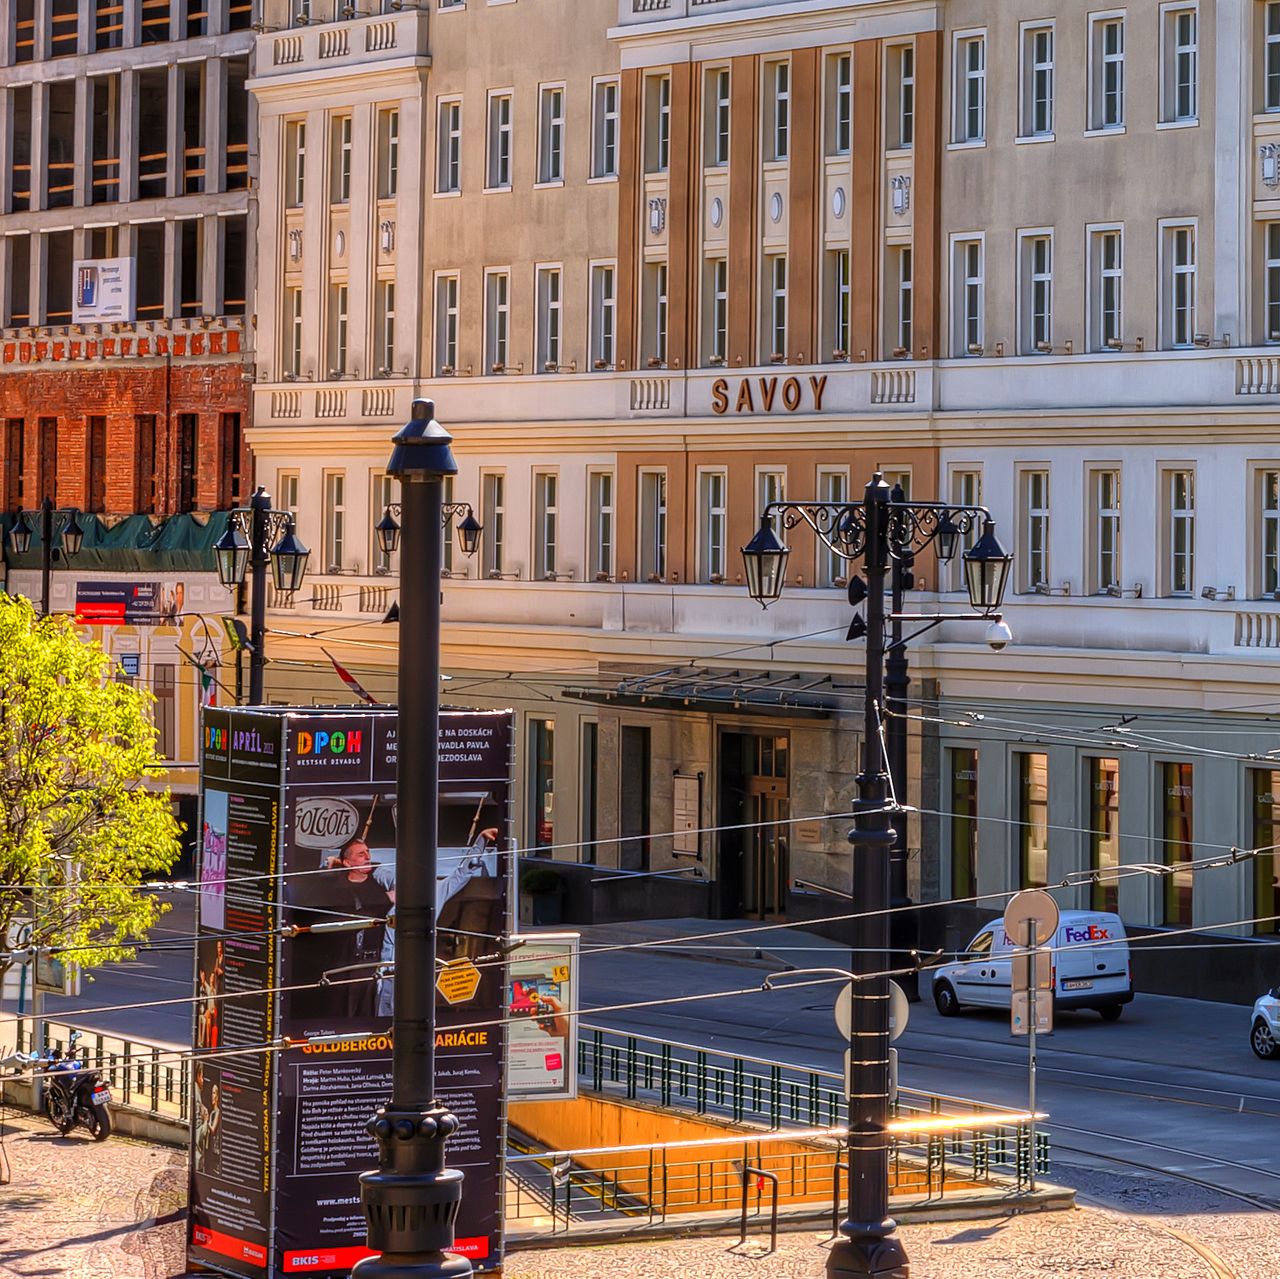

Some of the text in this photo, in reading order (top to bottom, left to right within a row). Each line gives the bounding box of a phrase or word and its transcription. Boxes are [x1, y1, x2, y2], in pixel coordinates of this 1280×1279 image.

[711, 375, 828, 414] SAVOY
[205, 727, 227, 751] DPOH
[233, 727, 262, 753] APRÍL
[445, 729, 455, 737] NA
[457, 727, 493, 737] DOSKÁCH
[297, 730, 362, 755] DPOH
[438, 741, 490, 750] IVADLA PAVLA
[297, 757, 361, 766] MESTSKÉ DIVADLO
[1066, 925, 1109, 942] FedEx
[435, 1030, 488, 1048] ARIÁCIE
[263, 1090, 268, 1105] NA
[292, 1256, 319, 1266] BKIS
